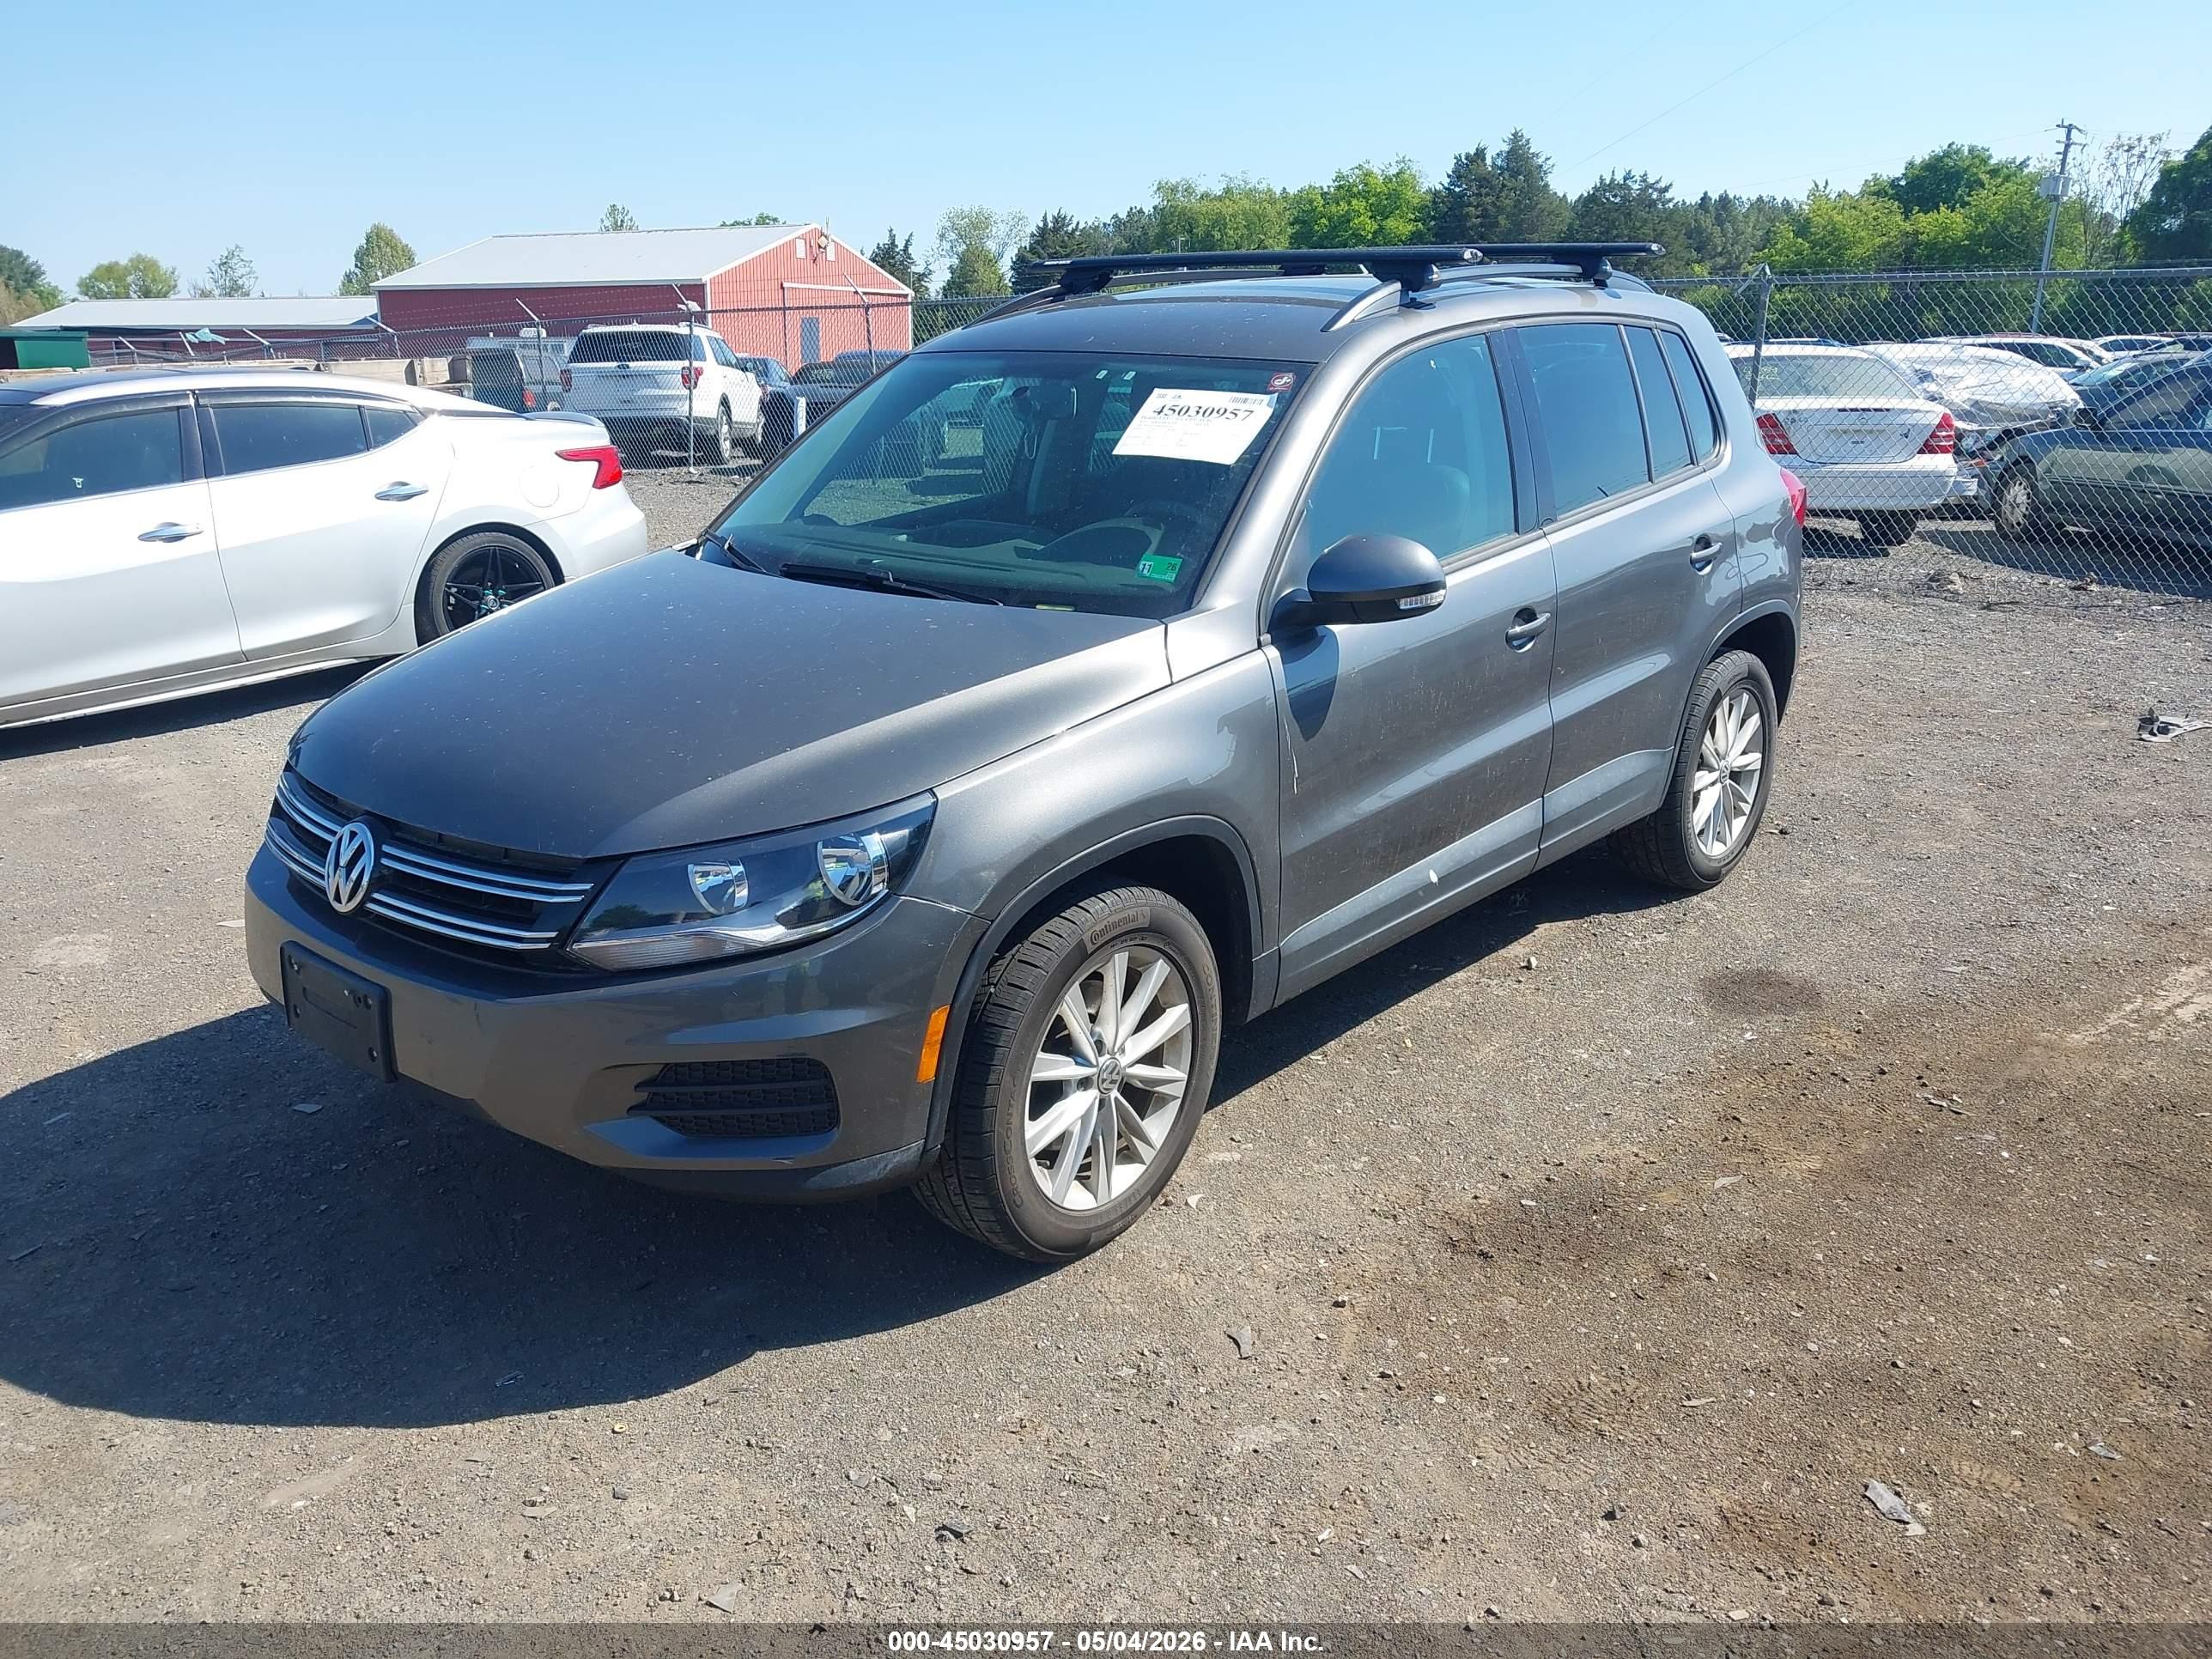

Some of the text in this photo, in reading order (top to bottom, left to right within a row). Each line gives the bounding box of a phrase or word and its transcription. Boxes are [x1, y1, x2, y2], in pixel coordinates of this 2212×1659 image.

[1153, 404, 1255, 422] 45030957
[325, 822, 374, 913] VW
[1090, 911, 1139, 945] Continental
